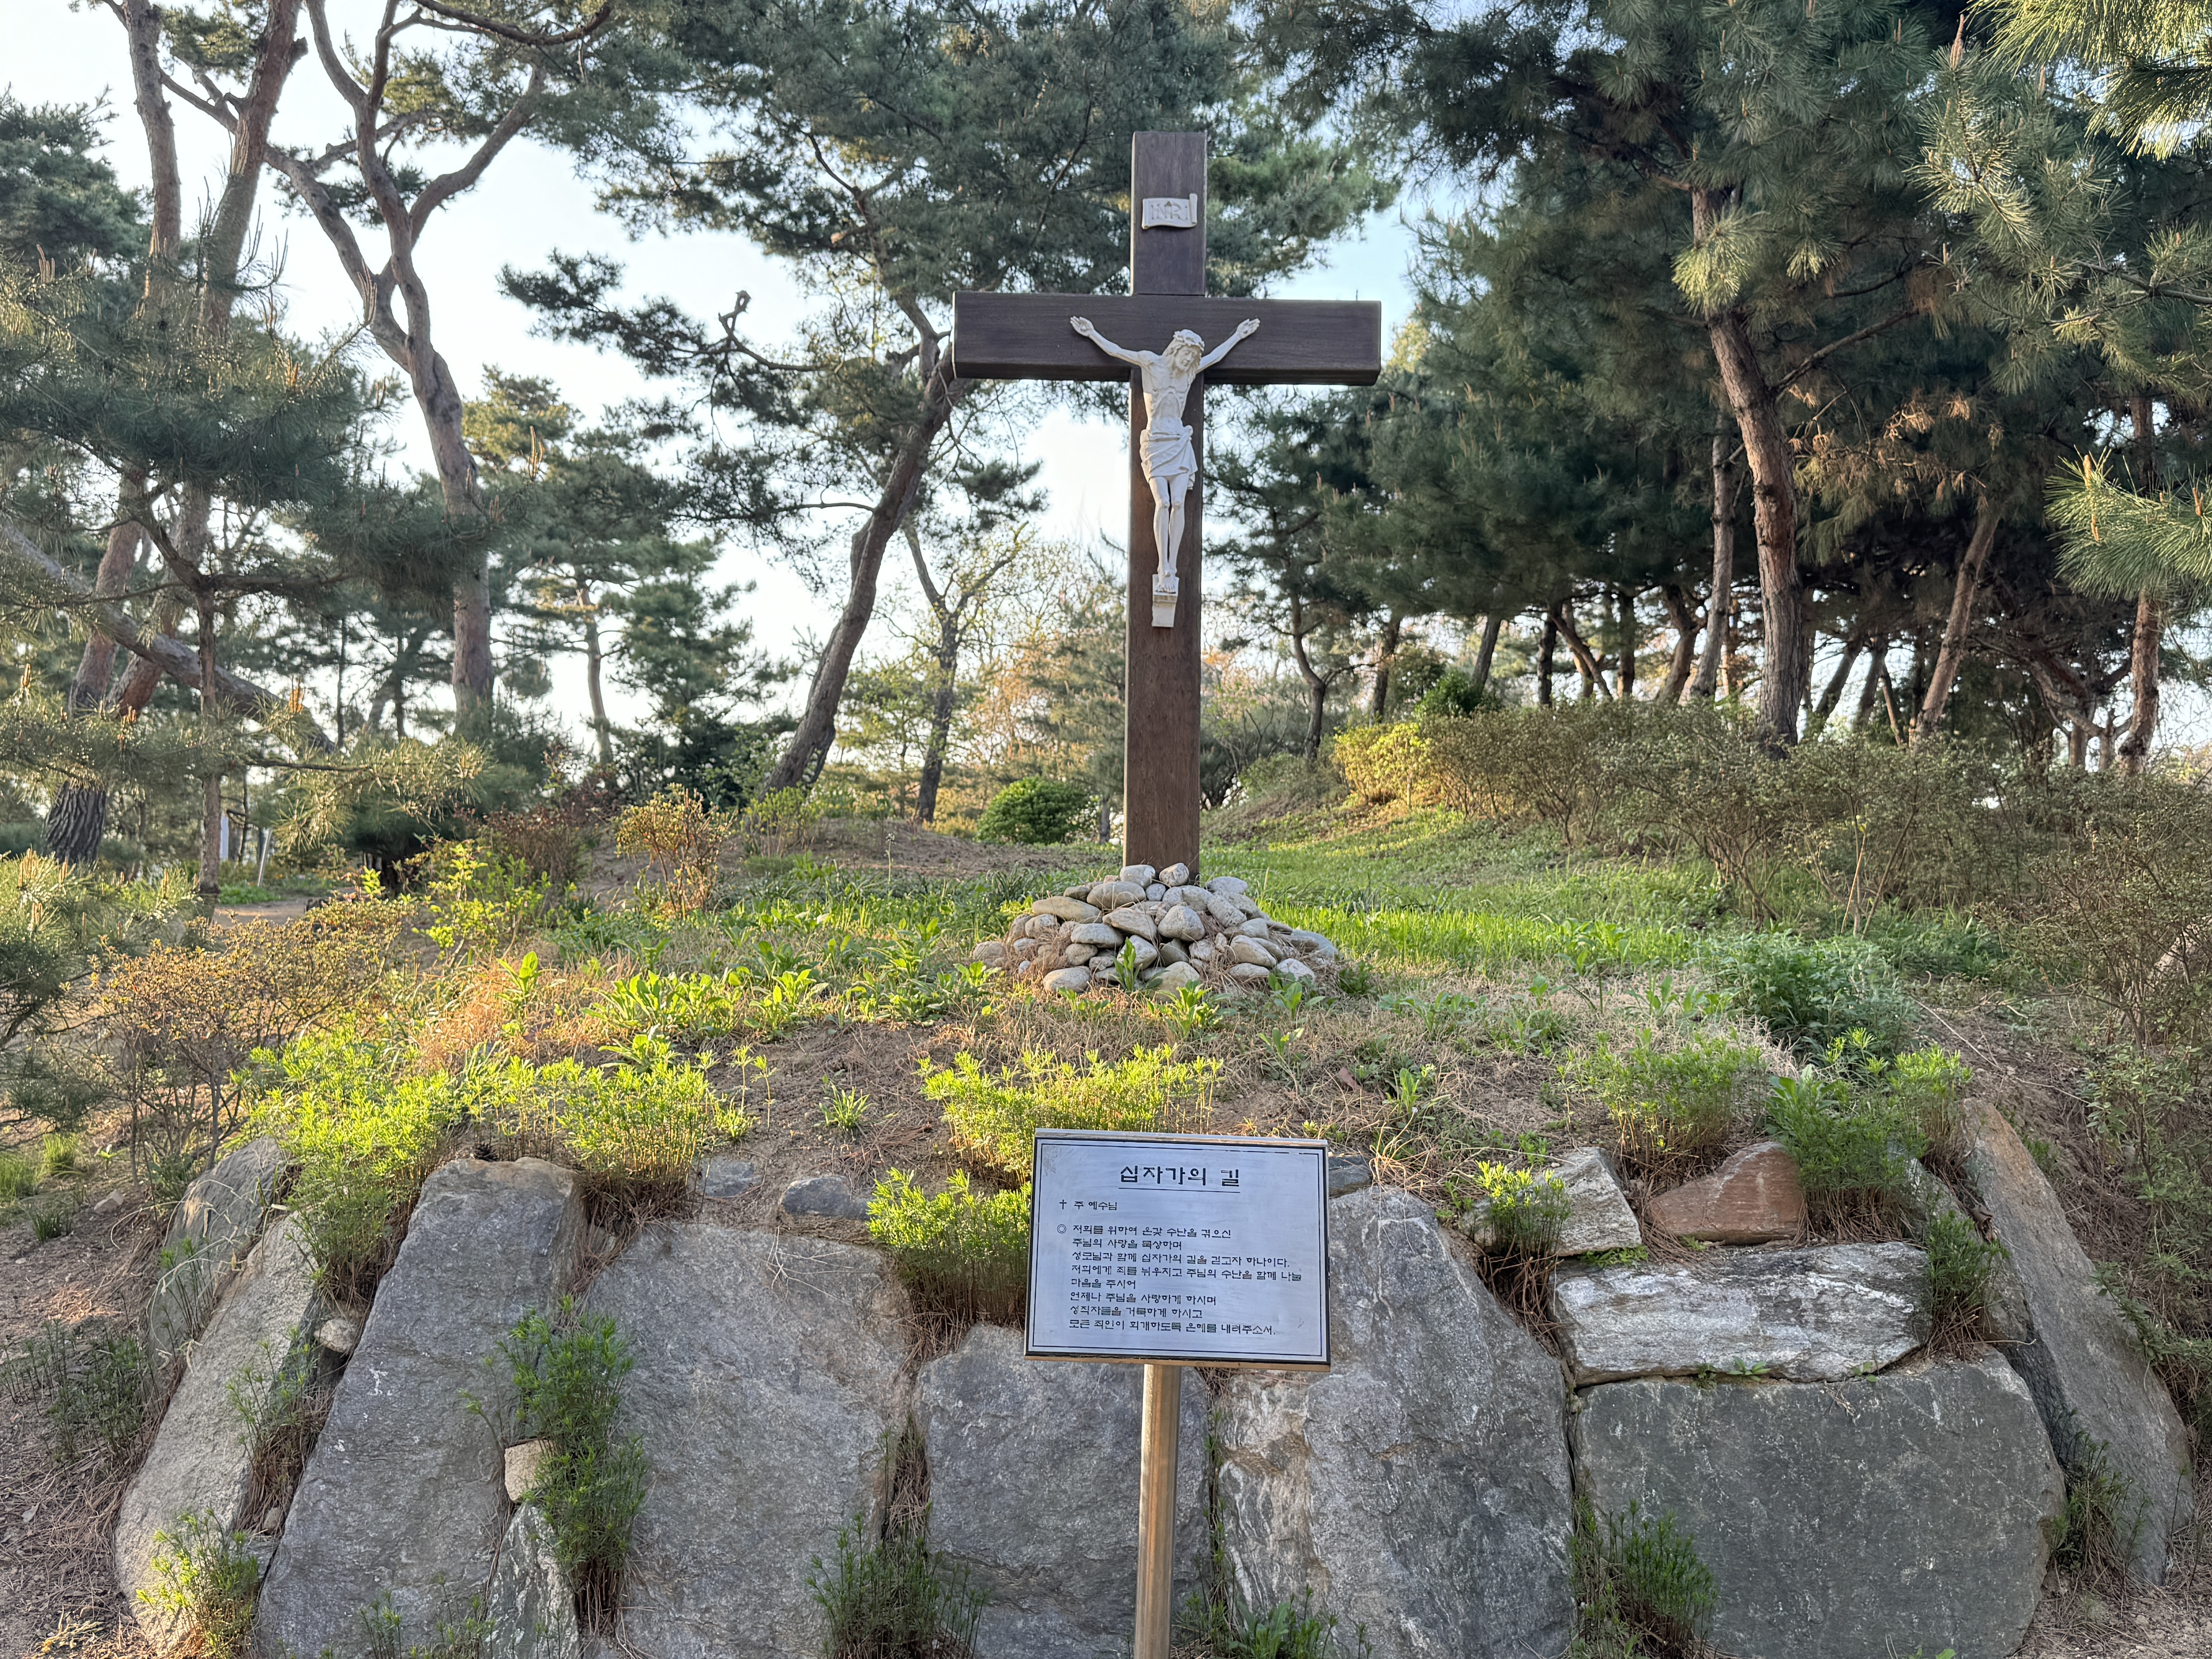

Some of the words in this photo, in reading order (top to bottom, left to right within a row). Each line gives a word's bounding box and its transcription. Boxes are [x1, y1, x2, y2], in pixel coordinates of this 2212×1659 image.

[1151, 204, 1188, 220] INRI
[1121, 1166, 1206, 1186] 십자가의
[1221, 1170, 1239, 1187] 길
[1074, 1201, 1084, 1209] 주
[1089, 1201, 1117, 1210] 예수님
[1073, 1225, 1103, 1234] 저희를
[1108, 1226, 1137, 1235] 위하여
[1142, 1227, 1163, 1236] 온갖
[1167, 1228, 1197, 1237] 수난을
[1201, 1230, 1231, 1238] 겪으신
[1072, 1238, 1102, 1248] 주님의
[1108, 1239, 1137, 1249] 사랑을
[1142, 1241, 1181, 1250] 묵상하며
[1072, 1252, 1113, 1261] 성모님과
[1117, 1253, 1136, 1262] 함께
[1142, 1254, 1181, 1264] 십자가의
[1187, 1255, 1207, 1264] 길을
[1211, 1256, 1242, 1266] 걷고자
[1246, 1257, 1289, 1267] 하나이다.
[1072, 1265, 1111, 1275] 저희에게
[1117, 1266, 1137, 1275] 죄를
[1187, 1269, 1216, 1278] 주님의
[1221, 1270, 1252, 1279] 수난을
[1257, 1271, 1276, 1280] 함께
[1281, 1272, 1301, 1281] 나눌
[1072, 1278, 1101, 1288] 마음을
[1106, 1280, 1135, 1289] 주시어
[1071, 1292, 1101, 1302] 언제나
[1106, 1293, 1136, 1302] 주님을
[1141, 1294, 1181, 1304] 사랑하게
[1186, 1295, 1216, 1305] 하시며
[1070, 1305, 1121, 1316] 성직자들을
[1126, 1307, 1166, 1317] 거룩하게
[1171, 1309, 1202, 1318] 하시고
[1069, 1320, 1090, 1328] 모든
[1094, 1320, 1124, 1330] 죄인이
[1130, 1321, 1181, 1332] 회개하도록
[1186, 1323, 1216, 1333] 은혜를
[1221, 1324, 1275, 1335] 내려주소서.
